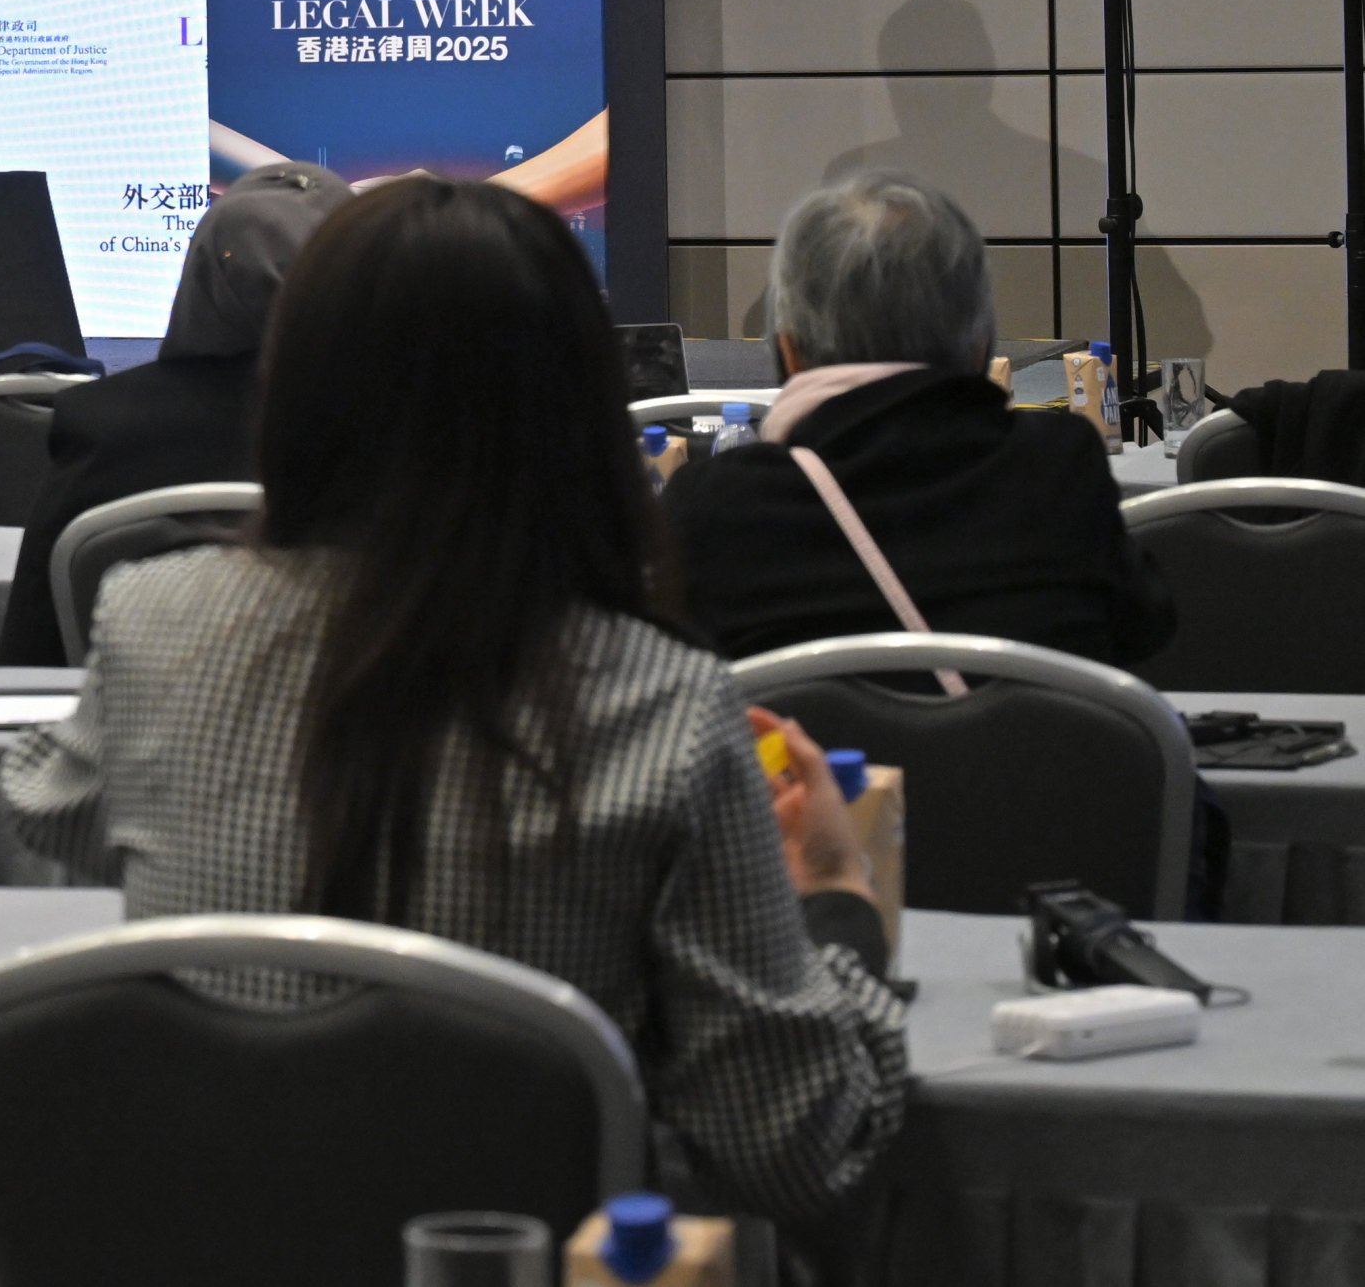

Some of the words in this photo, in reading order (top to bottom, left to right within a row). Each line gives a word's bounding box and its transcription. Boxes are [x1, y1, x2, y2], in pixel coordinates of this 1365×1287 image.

[272, 0, 404, 29] LEGAL
[59, 44, 72, 55] of
[73, 45, 107, 55] Justice
[297, 35, 508, 62] 香港法律周2025
